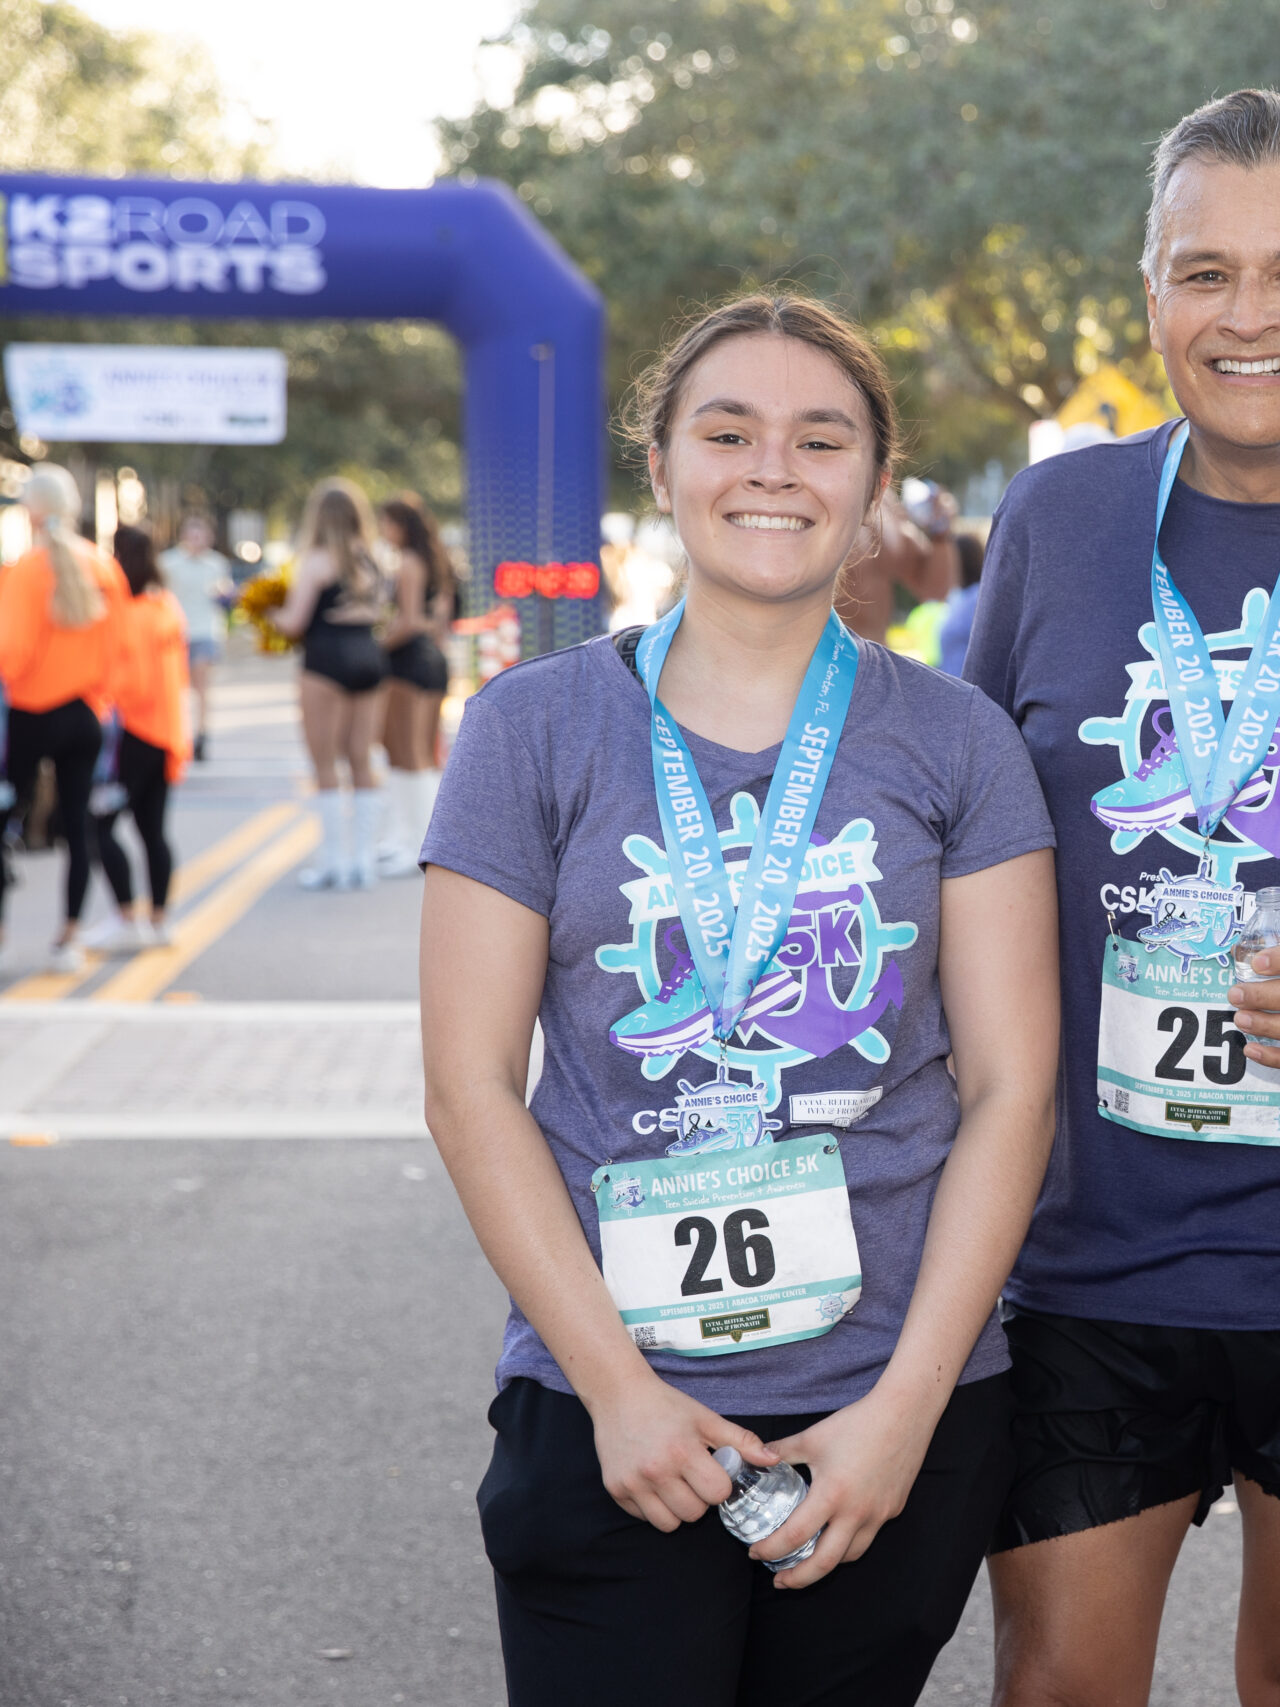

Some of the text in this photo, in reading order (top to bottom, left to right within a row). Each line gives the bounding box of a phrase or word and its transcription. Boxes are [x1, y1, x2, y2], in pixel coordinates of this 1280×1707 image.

[11, 242, 326, 294] SPORTS
[1155, 562, 1219, 759] TEMBER 20, 2025
[814, 700, 830, 716] FL
[1228, 706, 1269, 766] 2025
[654, 714, 705, 844] SEPTEMBER
[744, 721, 830, 964] SEPTEMBER 20, 2025
[683, 846, 713, 889] 20,
[1162, 887, 1234, 902] ANNIE'S CHOICE
[692, 892, 731, 957] 2025
[776, 909, 861, 968] 5K
[1200, 908, 1228, 931] 5K
[1172, 987, 1199, 998] Suicide
[1155, 1007, 1247, 1085] 25
[684, 1092, 758, 1108] ANNIE'S CHOICE
[1225, 1093, 1245, 1101] TOWN
[1247, 1094, 1270, 1103] CENTER
[727, 1113, 755, 1132] 5K
[651, 1153, 819, 1197] ANNIE'S CHOICE 5K
[664, 1199, 681, 1209] Teen
[683, 1194, 710, 1207] Suicide
[712, 1189, 755, 1203] Prevention
[766, 1182, 806, 1195] Awareness
[674, 1208, 776, 1296] 26
[732, 1295, 759, 1307] ABACOA
[760, 1292, 781, 1303] TOWN
[782, 1287, 807, 1298] CENTER
